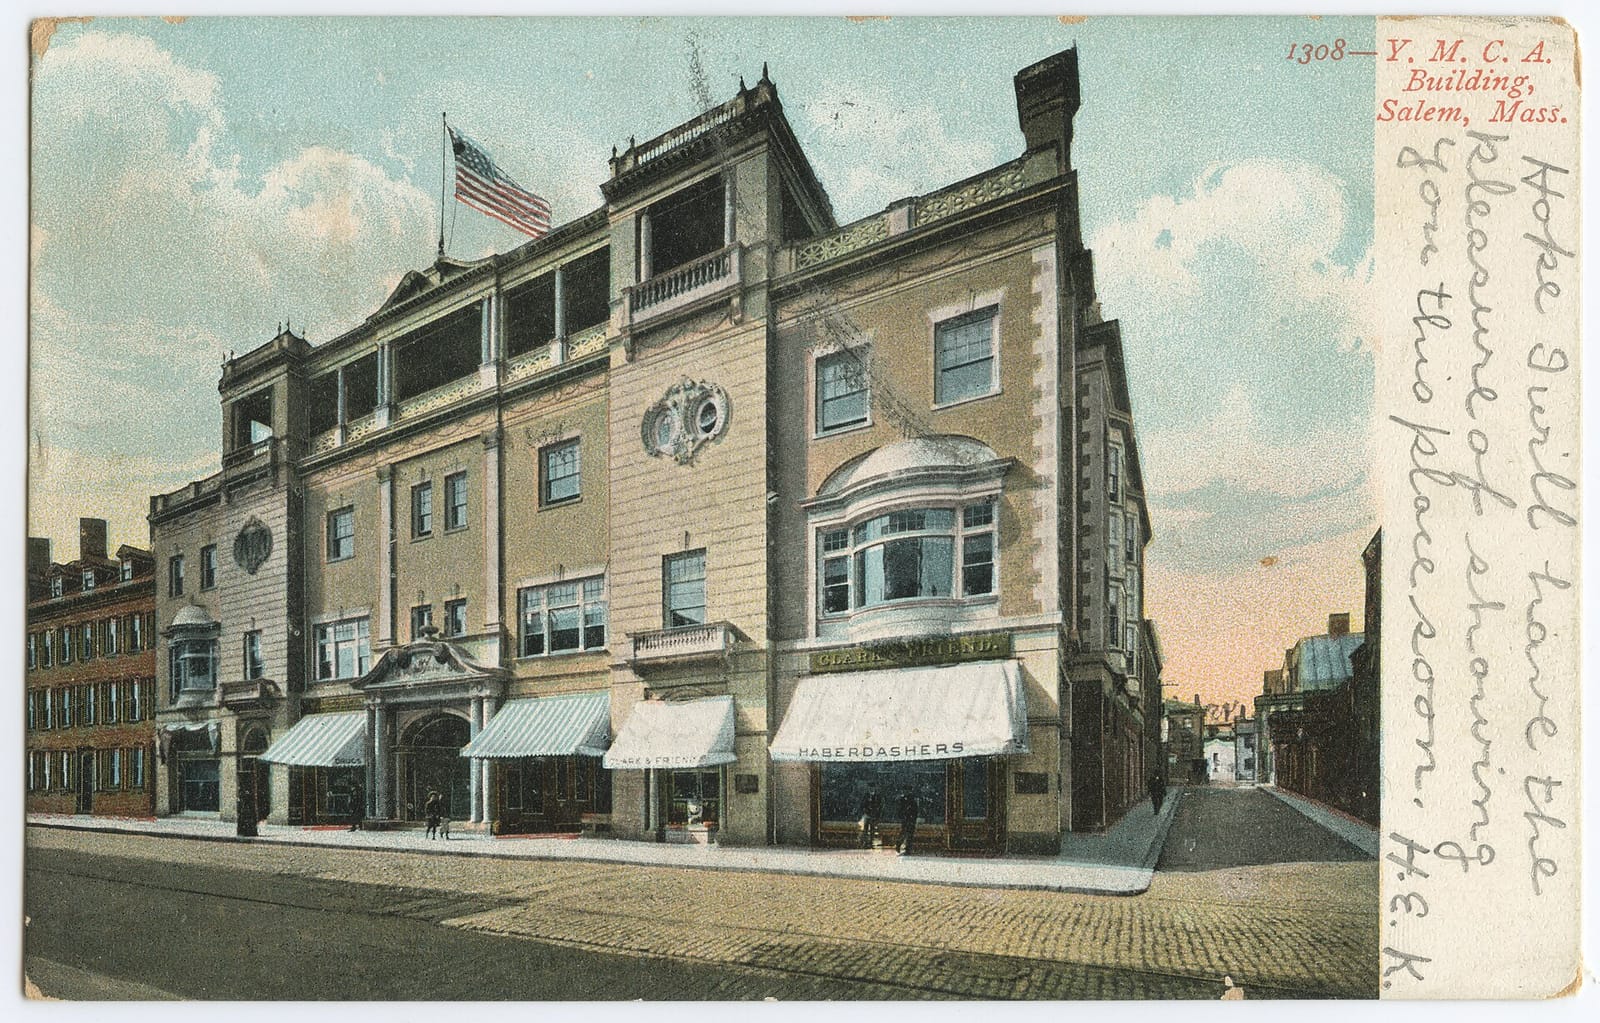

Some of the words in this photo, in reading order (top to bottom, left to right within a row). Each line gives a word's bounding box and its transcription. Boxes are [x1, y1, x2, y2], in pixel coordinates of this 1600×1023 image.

[1465, 130, 1517, 420] pleasure
[1521, 156, 1576, 314] Hope
[1412, 282, 1453, 403] this
[1388, 415, 1457, 588] place
[1450, 429, 1518, 516] of
[1527, 386, 1578, 530] will
[1408, 595, 1436, 808] soon.
[1433, 532, 1506, 873] showing
[1525, 560, 1572, 751] have
[800, 742, 964, 758] HABERDASHERS
[1524, 776, 1566, 896] the
